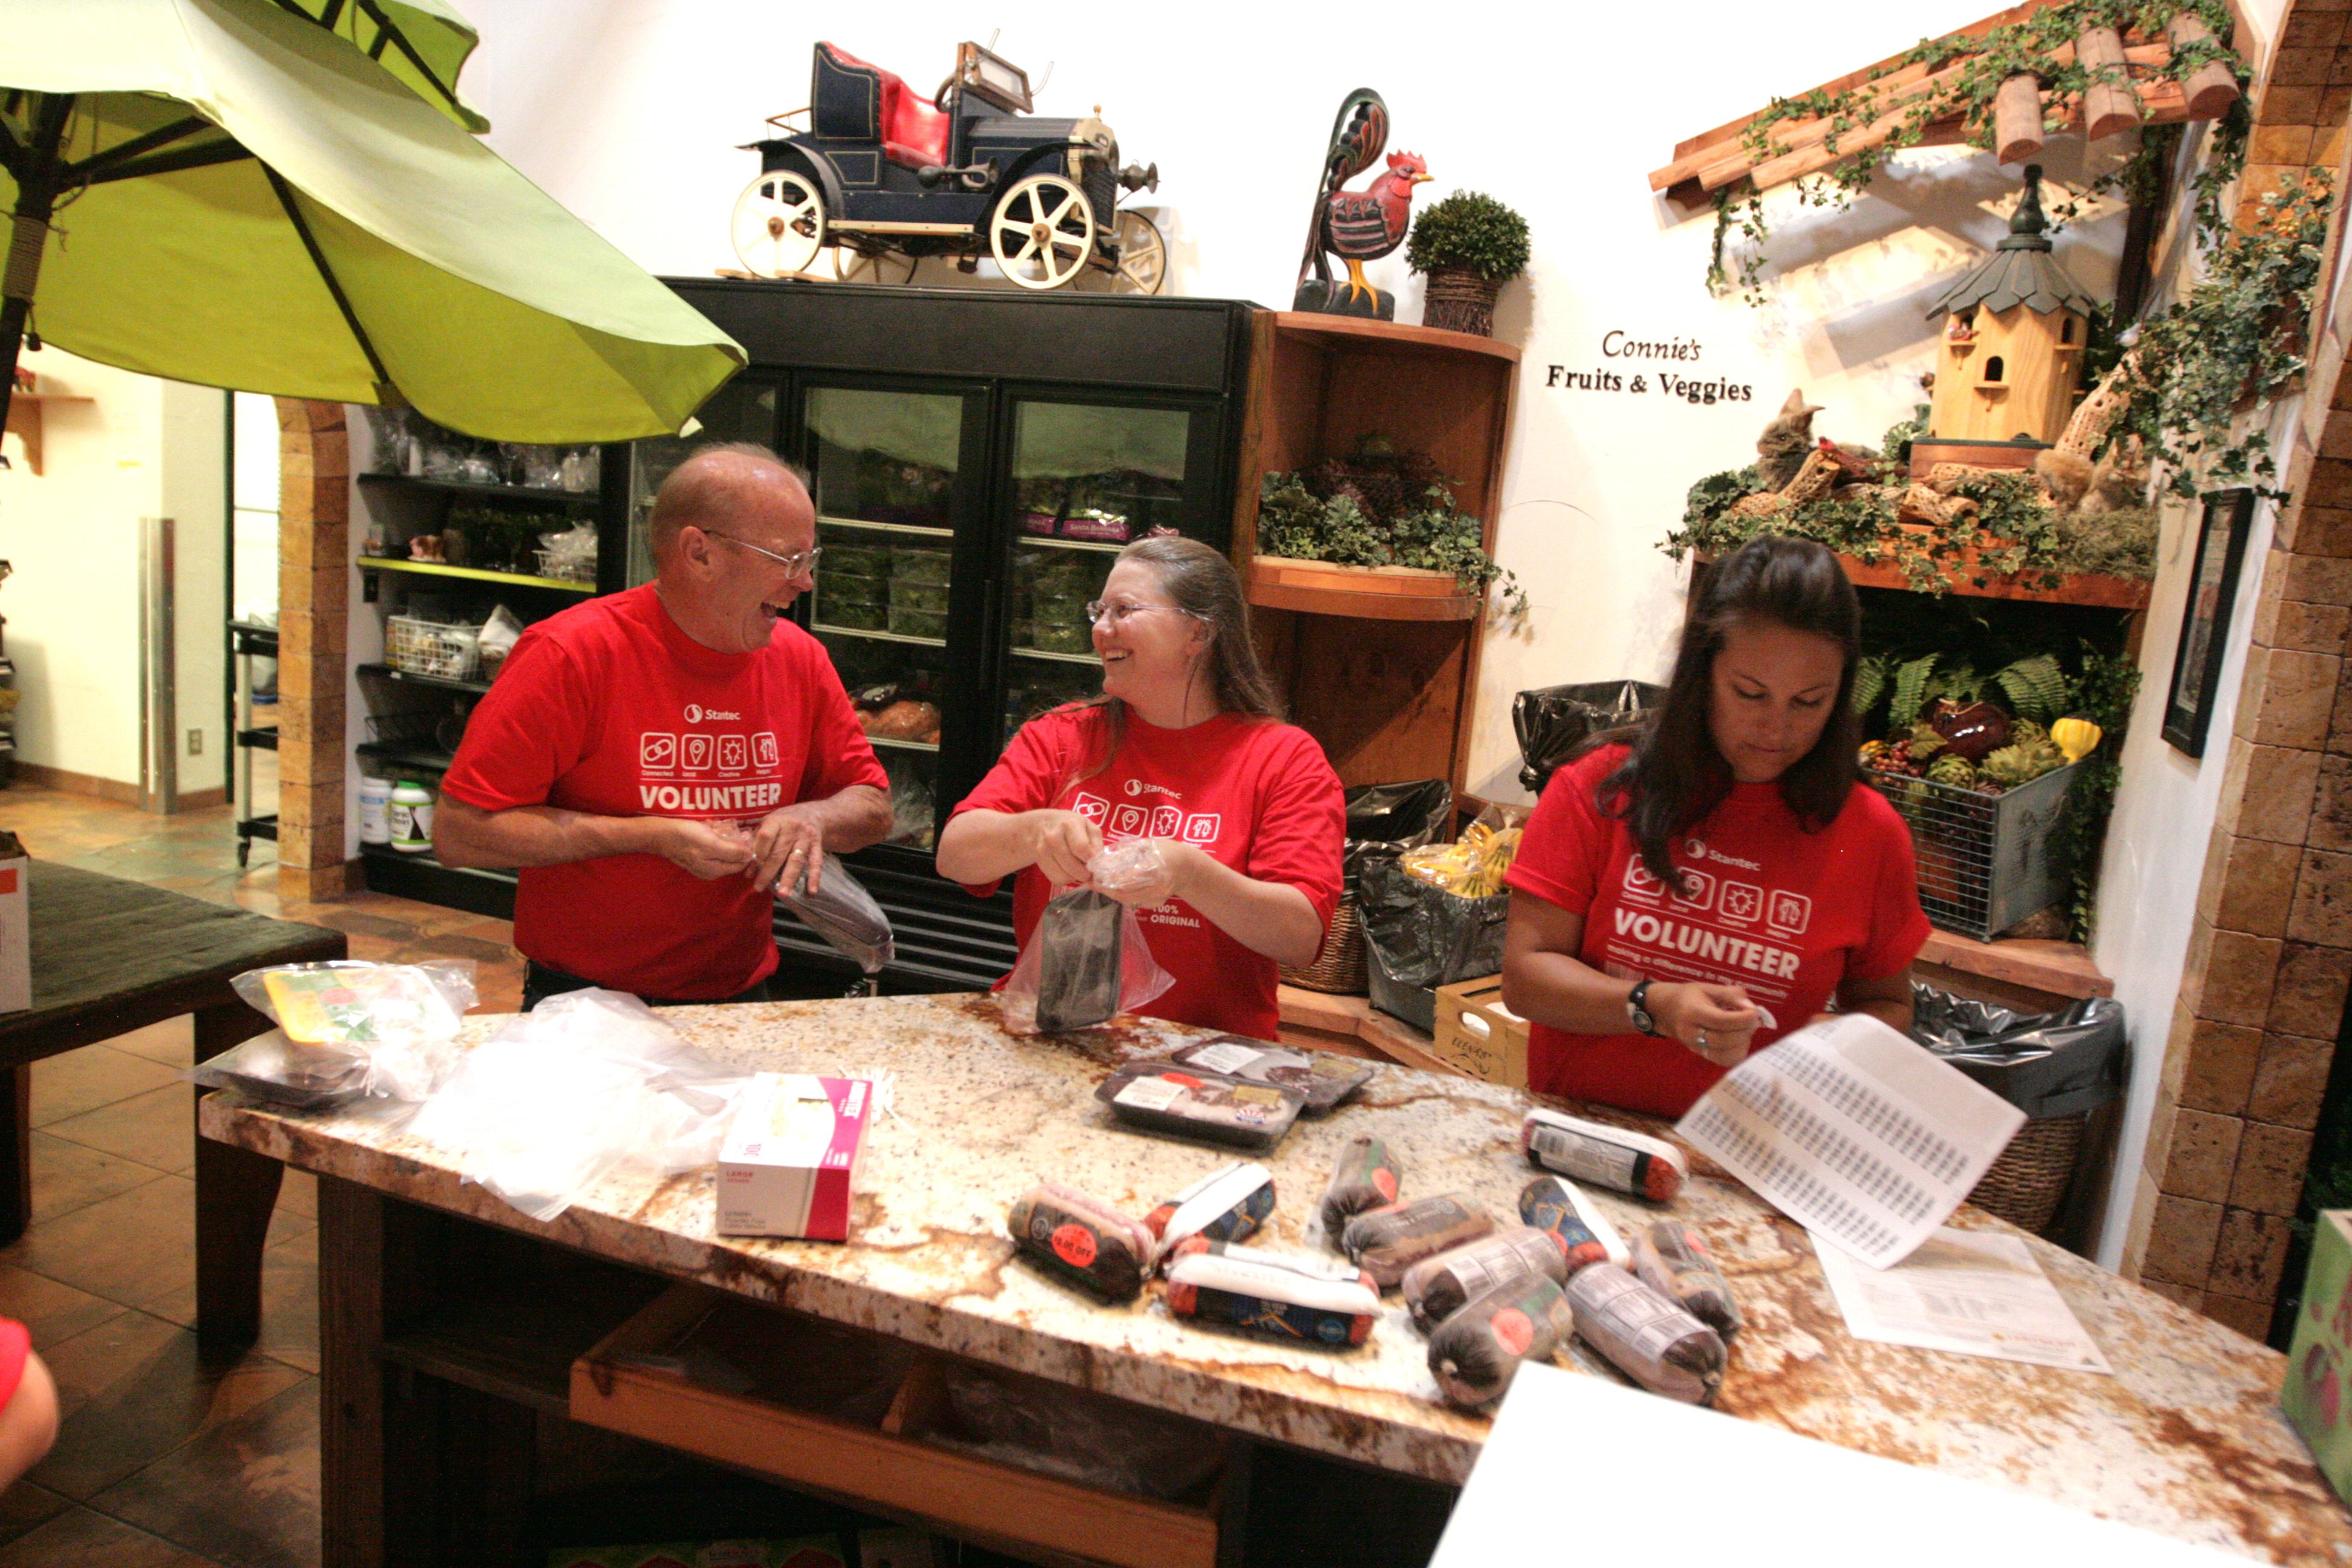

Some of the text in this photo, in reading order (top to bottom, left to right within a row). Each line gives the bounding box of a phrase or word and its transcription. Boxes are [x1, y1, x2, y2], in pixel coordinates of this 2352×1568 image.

[1602, 330, 1702, 361] Connie's
[1546, 364, 1753, 405] Fruits & Veggies
[705, 708, 741, 720] Stantec
[639, 783, 782, 810] VOLUNTEER
[1708, 849, 1761, 871] Stantec
[1151, 914, 1200, 928] ORIGINAL
[1614, 907, 1800, 981] VOLUNTEER
[1607, 944, 1642, 963] making
[1652, 958, 1704, 978] difference
